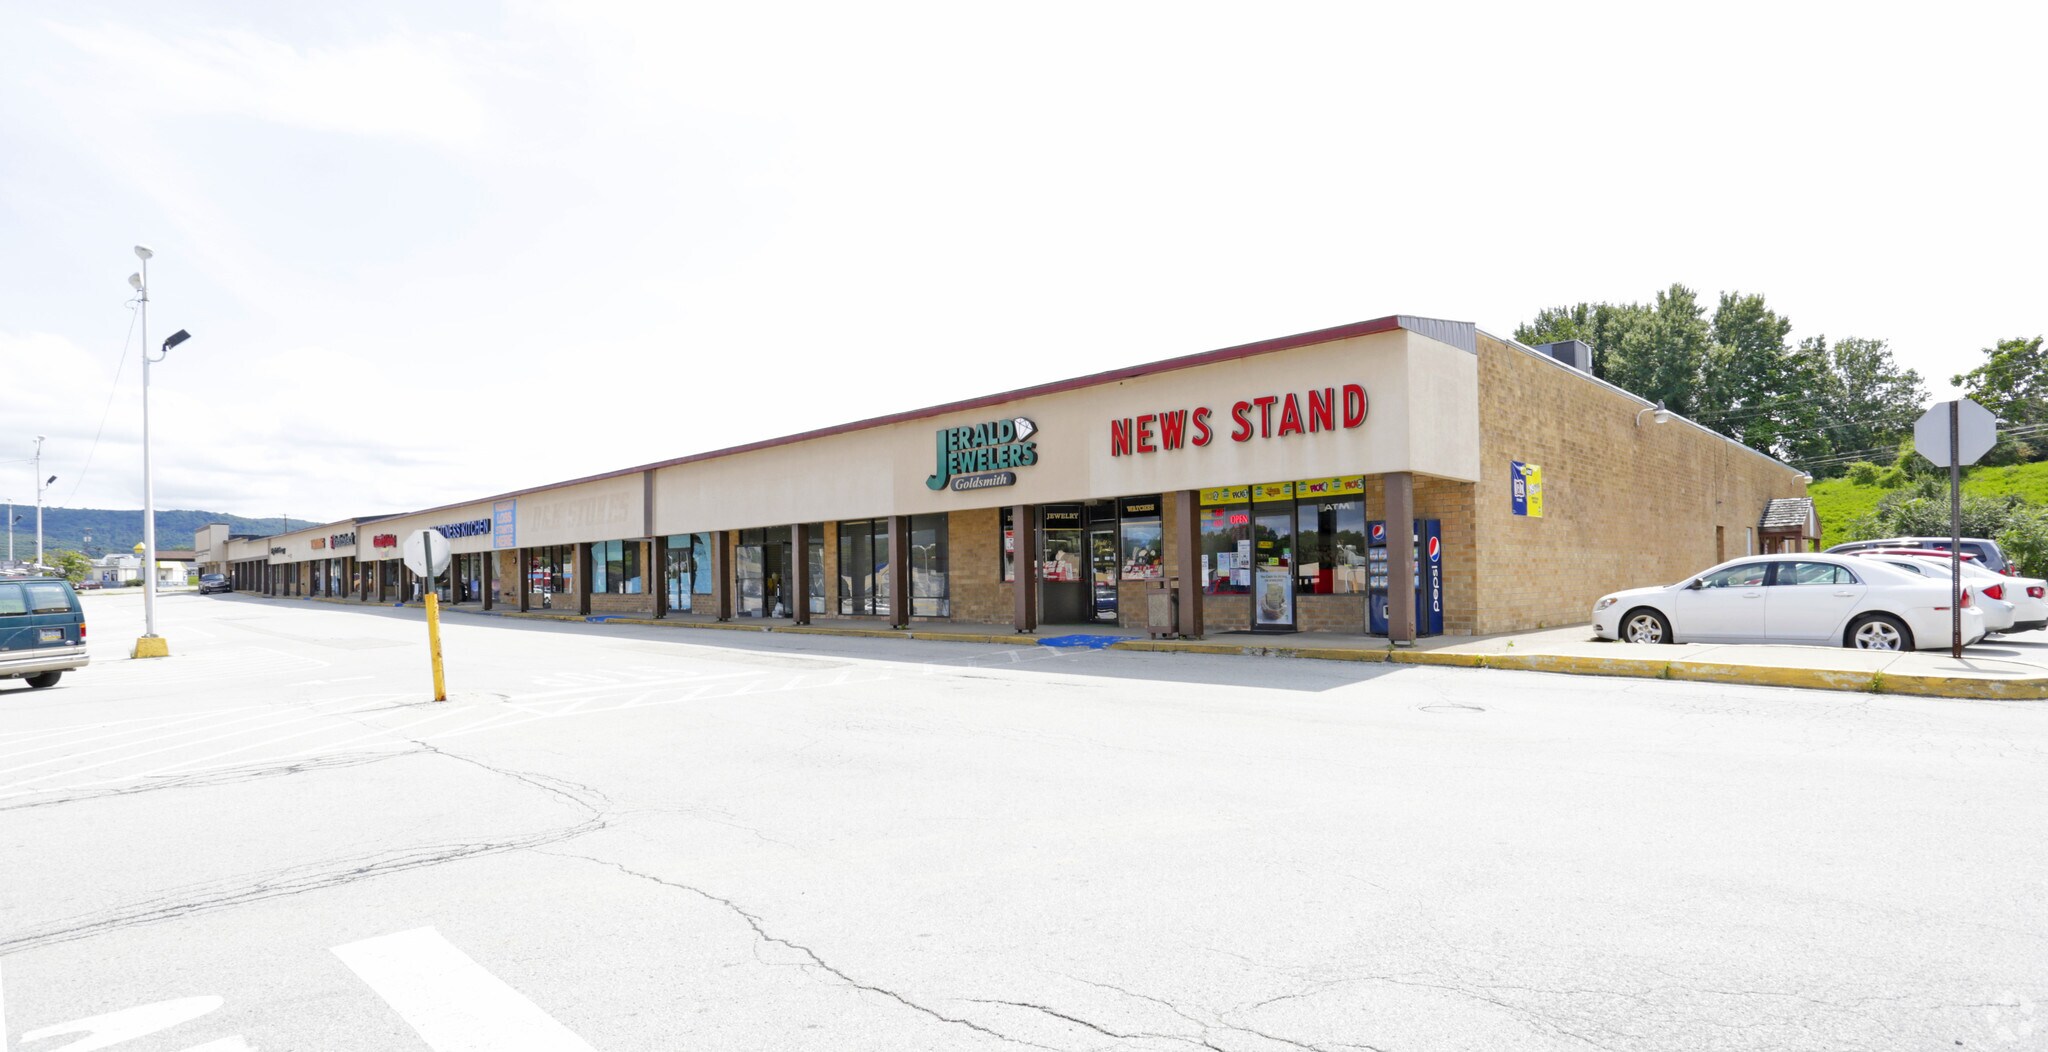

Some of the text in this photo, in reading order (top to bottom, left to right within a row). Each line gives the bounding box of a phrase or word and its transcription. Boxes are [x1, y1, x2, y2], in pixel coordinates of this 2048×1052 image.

[1112, 384, 1368, 457] NEWS STAND
[955, 474, 1008, 490] Goldsmith
[1324, 503, 1350, 512] ATM
[1046, 512, 1079, 520] JEWELRY
[1230, 514, 1249, 525] OPEN
[1431, 565, 1440, 612] pepsi
